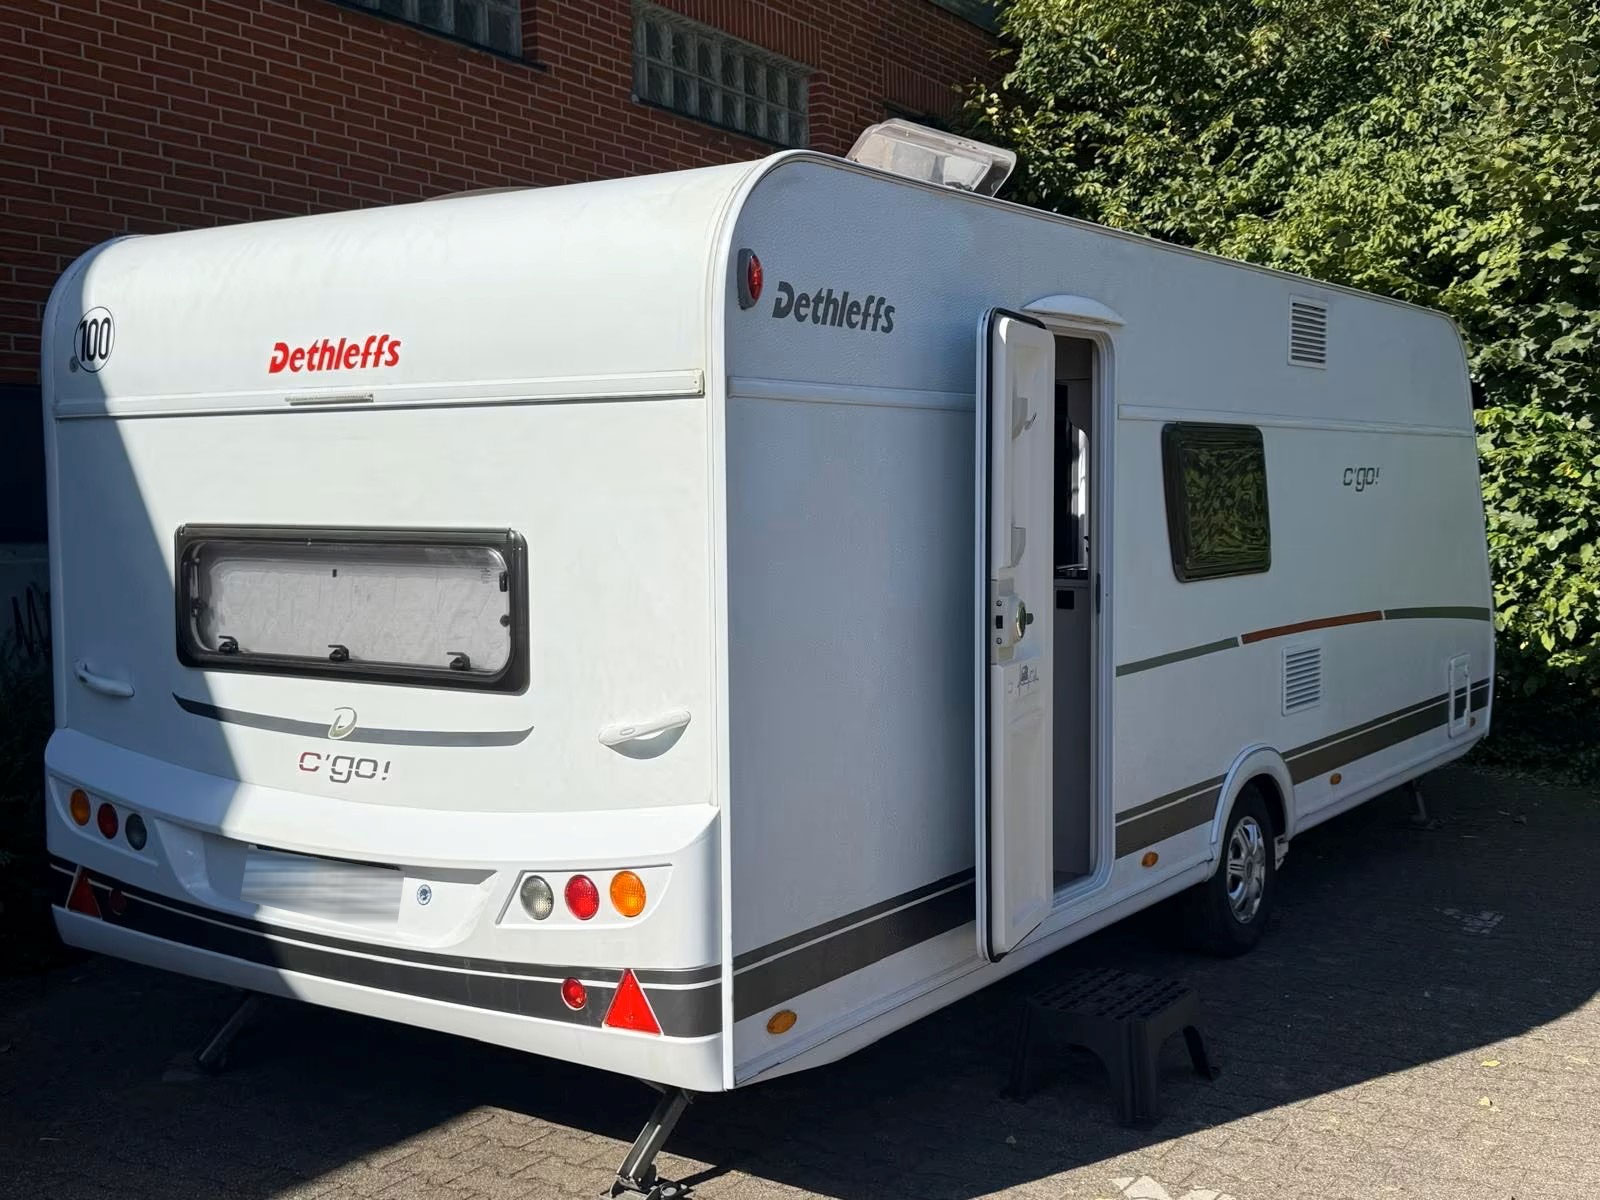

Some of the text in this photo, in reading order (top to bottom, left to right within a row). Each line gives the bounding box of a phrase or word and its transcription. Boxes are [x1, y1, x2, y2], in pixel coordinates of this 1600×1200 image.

[772, 280, 896, 334] Dethleffs
[80, 317, 111, 362] 100
[268, 334, 402, 374] Dethleffs
